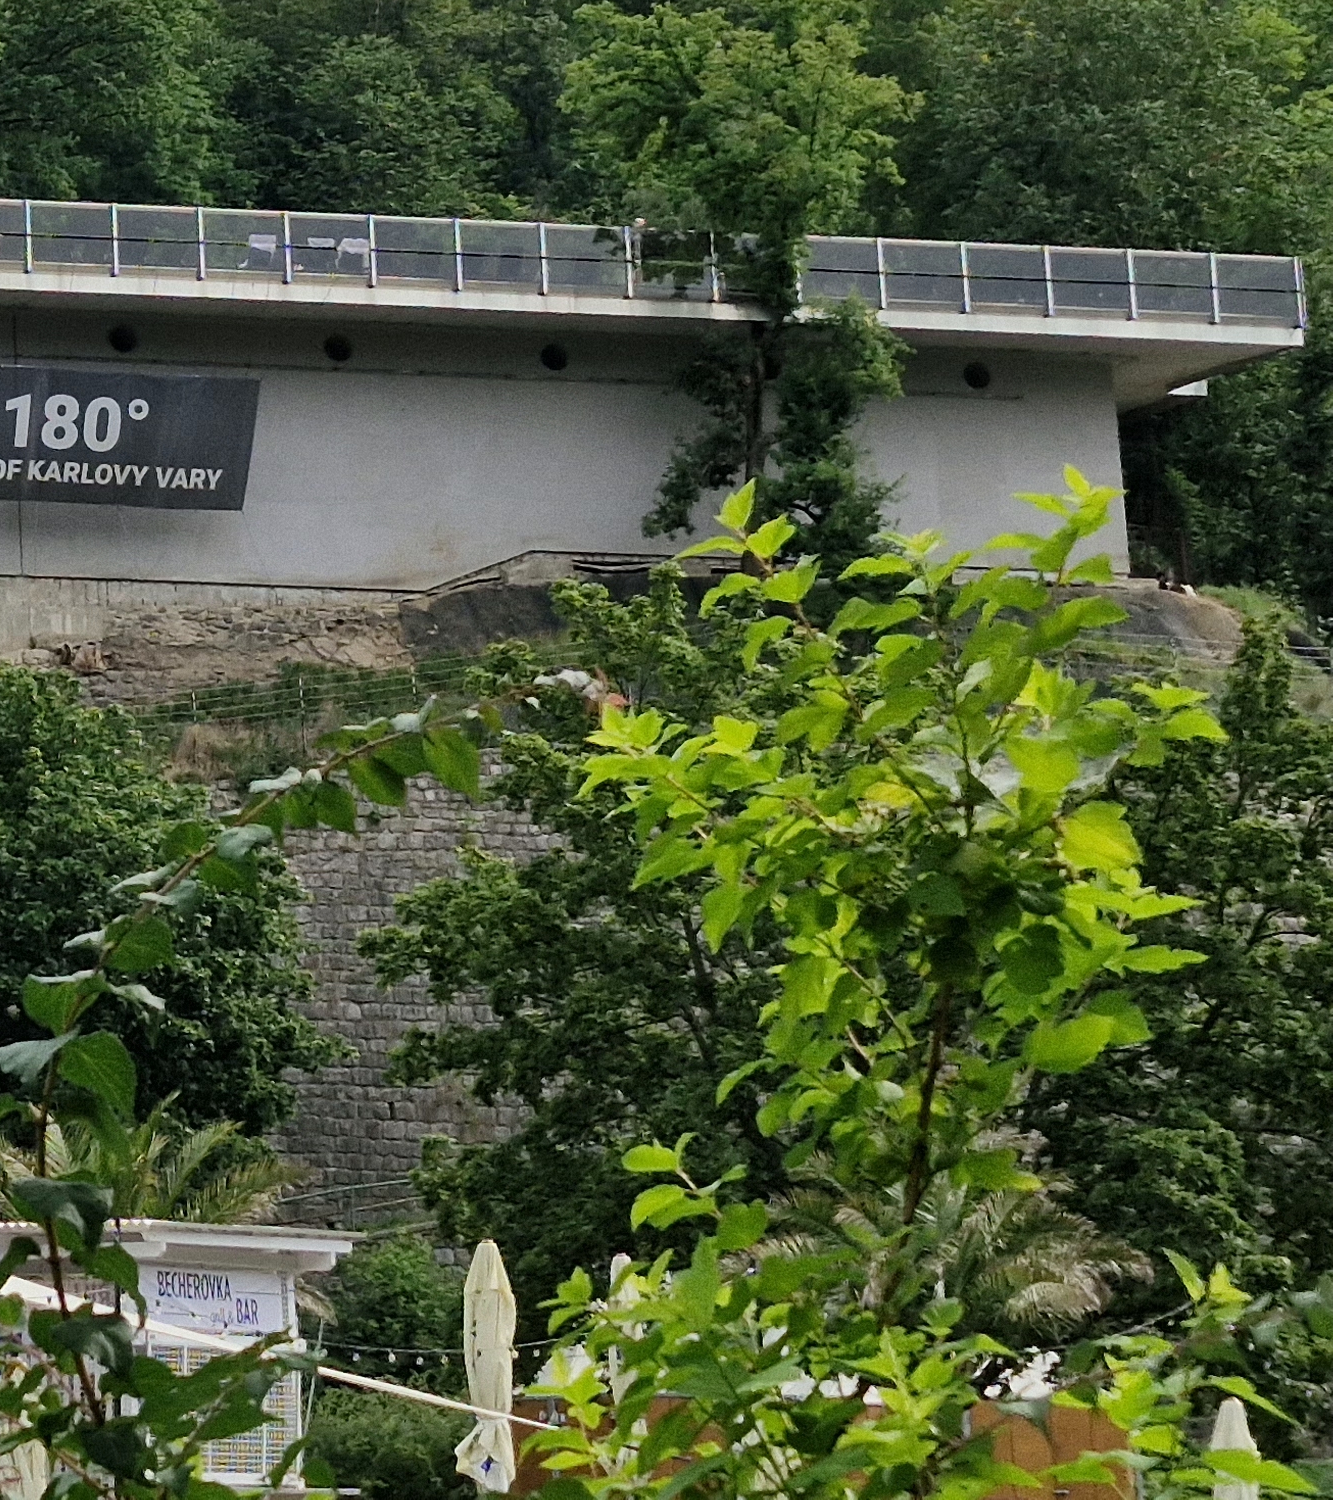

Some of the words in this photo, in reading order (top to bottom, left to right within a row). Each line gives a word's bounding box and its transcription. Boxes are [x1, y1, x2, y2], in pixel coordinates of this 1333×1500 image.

[5, 394, 149, 452] 180°
[27, 459, 149, 486] KARLOVY
[155, 466, 223, 490] VARY
[156, 1270, 232, 1301] BECHEROVKA
[235, 1298, 259, 1325] BAR
